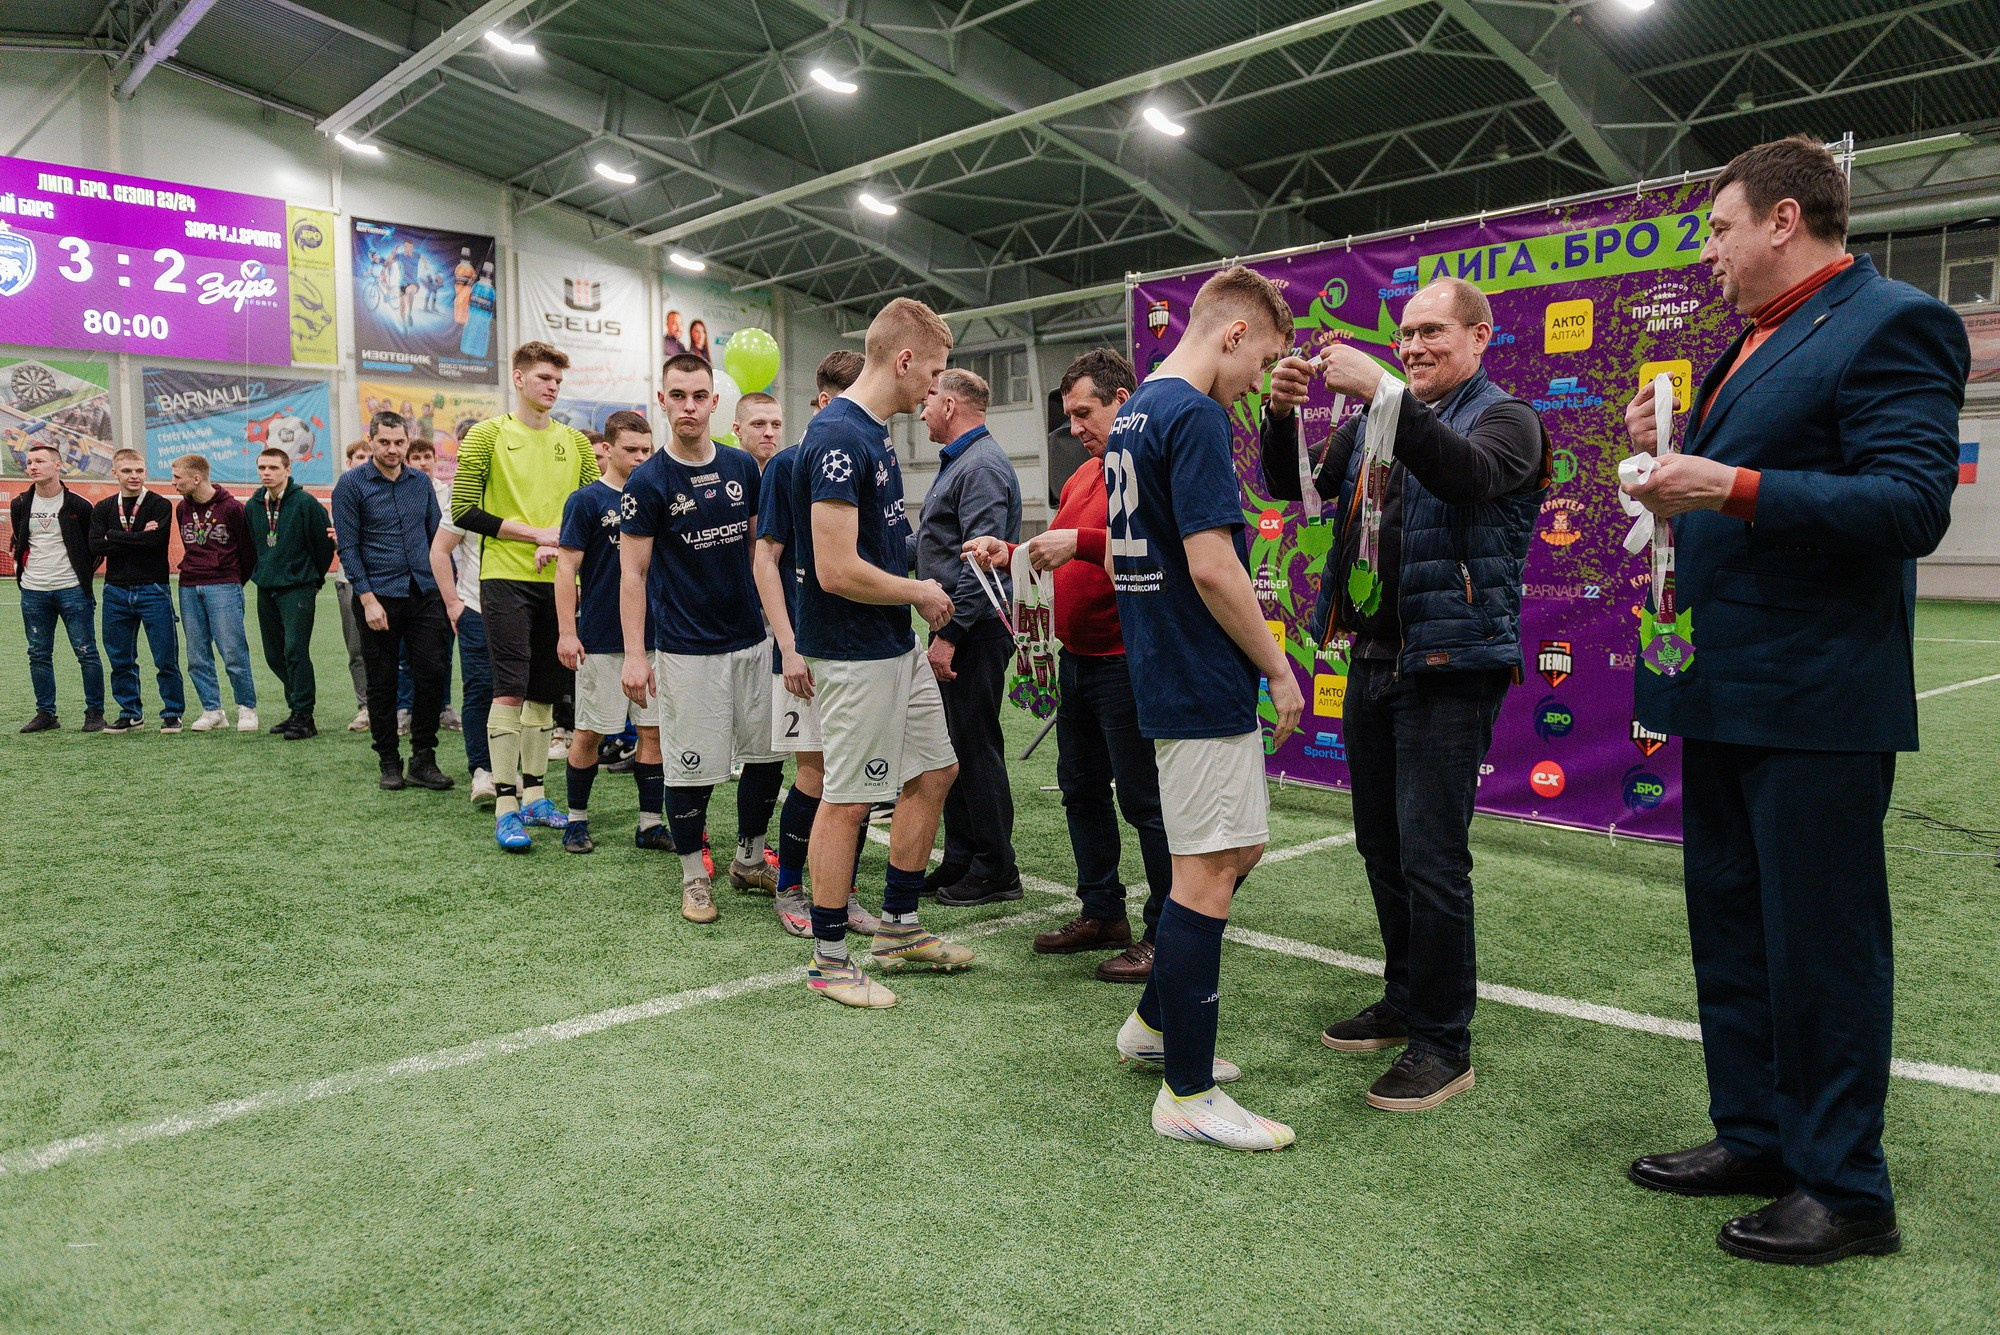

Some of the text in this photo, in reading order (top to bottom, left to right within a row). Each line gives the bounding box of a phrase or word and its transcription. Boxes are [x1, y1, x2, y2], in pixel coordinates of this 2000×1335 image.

[37, 172, 74, 195] ЛИГА
[113, 184, 155, 207] СЕЗОН
[156, 190, 197, 213] 23/24
[18, 197, 55, 219] БАРС
[1429, 242, 1537, 284] ЛИГА
[1550, 223, 1660, 272] .БРО
[57, 235, 94, 283] 3
[153, 248, 188, 294] 2
[196, 272, 278, 313] Заря
[1377, 283, 1418, 300] Sport
[1643, 282, 1690, 298] БАРБЕРШОП
[1632, 299, 1700, 319] ПРЕМЬЕР
[83, 308, 169, 340] 80:00
[545, 313, 622, 336] SEUS
[1551, 315, 1586, 329] АКТО
[1645, 316, 1684, 333] ЛИГА
[1550, 328, 1586, 341] АЛТАЙ
[361, 349, 432, 366] ИЗОТОНИК
[1303, 403, 1365, 420] iBARNUL22
[1532, 394, 1603, 412] SportLife
[1104, 448, 1148, 558] 22
[1540, 498, 1585, 515] КРАФТЕР
[681, 520, 749, 545] V.J.SPORTS
[1252, 578, 1289, 590] РЕМЬЕР
[1255, 590, 1279, 601] ЛИГА
[1315, 649, 1341, 661] ЛИГА
[1538, 653, 1572, 674] ТЕМП
[1319, 687, 1344, 698] АКТО
[784, 711, 800, 738] 2
[1543, 711, 1572, 725] .БРО
[1303, 745, 1347, 761] SportLi
[1632, 781, 1663, 797] .БРО
